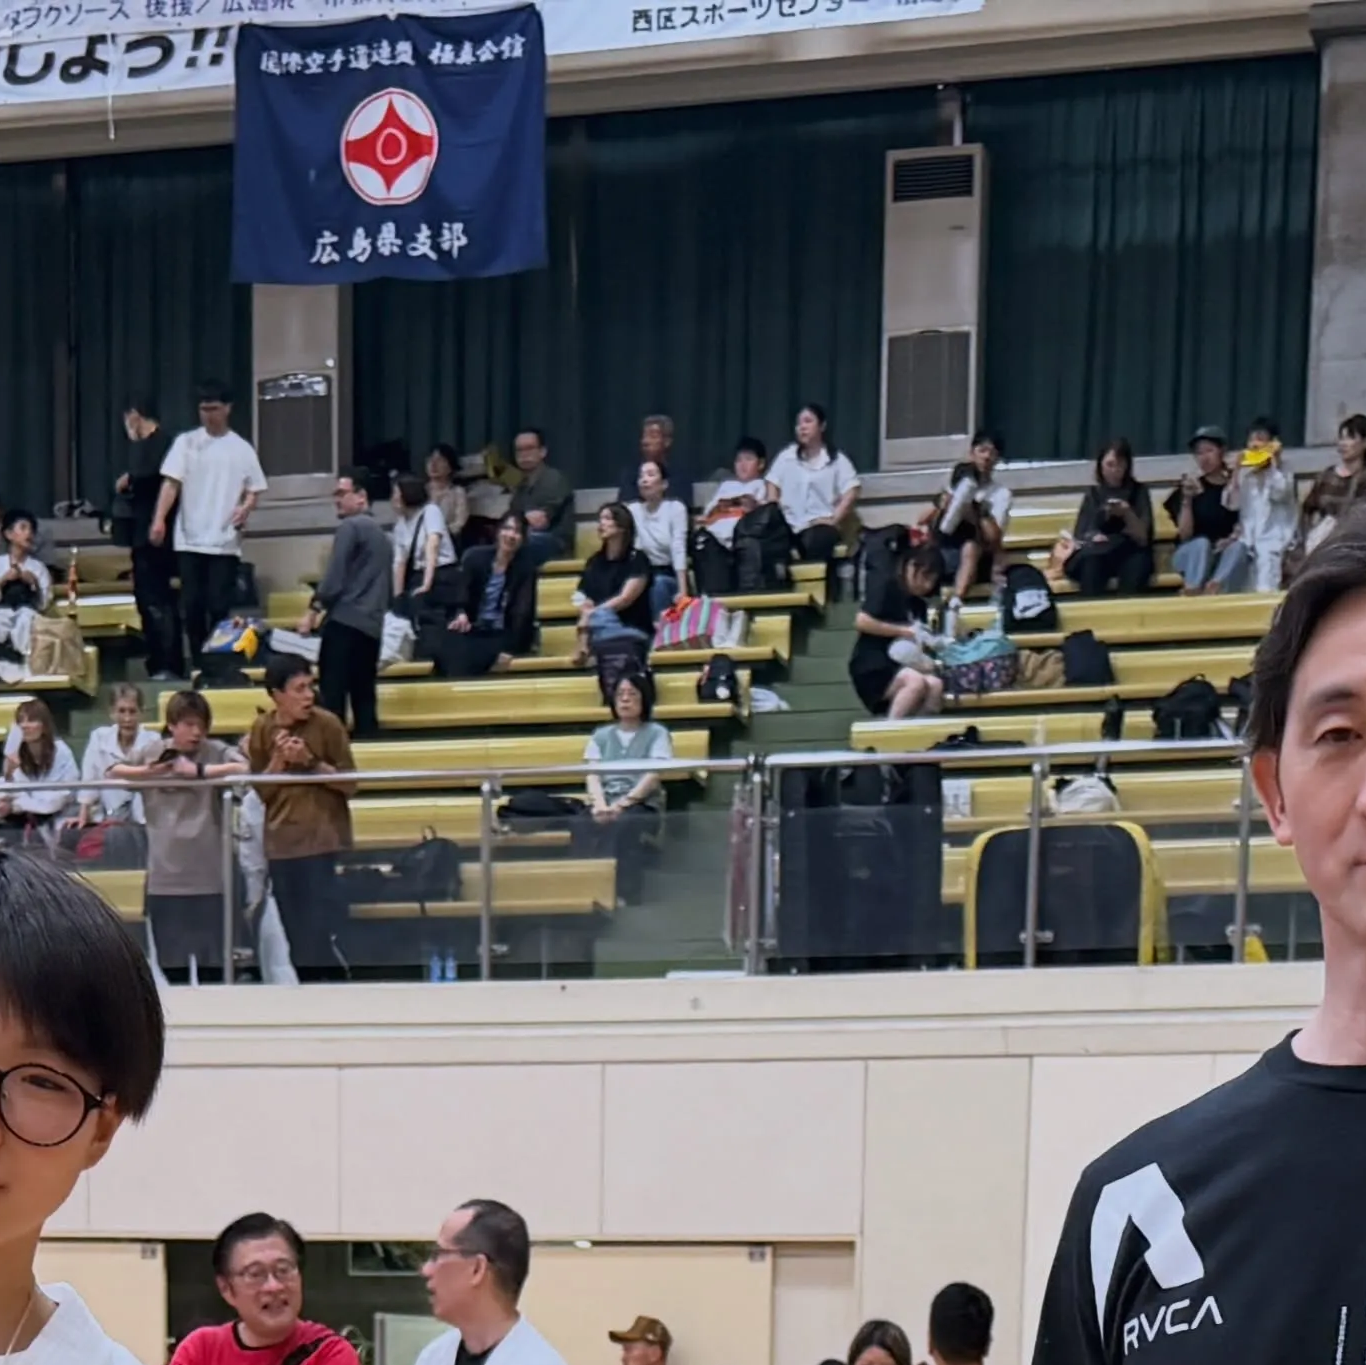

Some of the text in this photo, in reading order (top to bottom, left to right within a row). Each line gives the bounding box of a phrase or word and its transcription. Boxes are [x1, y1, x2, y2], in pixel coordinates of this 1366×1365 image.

[310, 222, 468, 265] 広島県支部
[1124, 1295, 1223, 1356] RVCA
